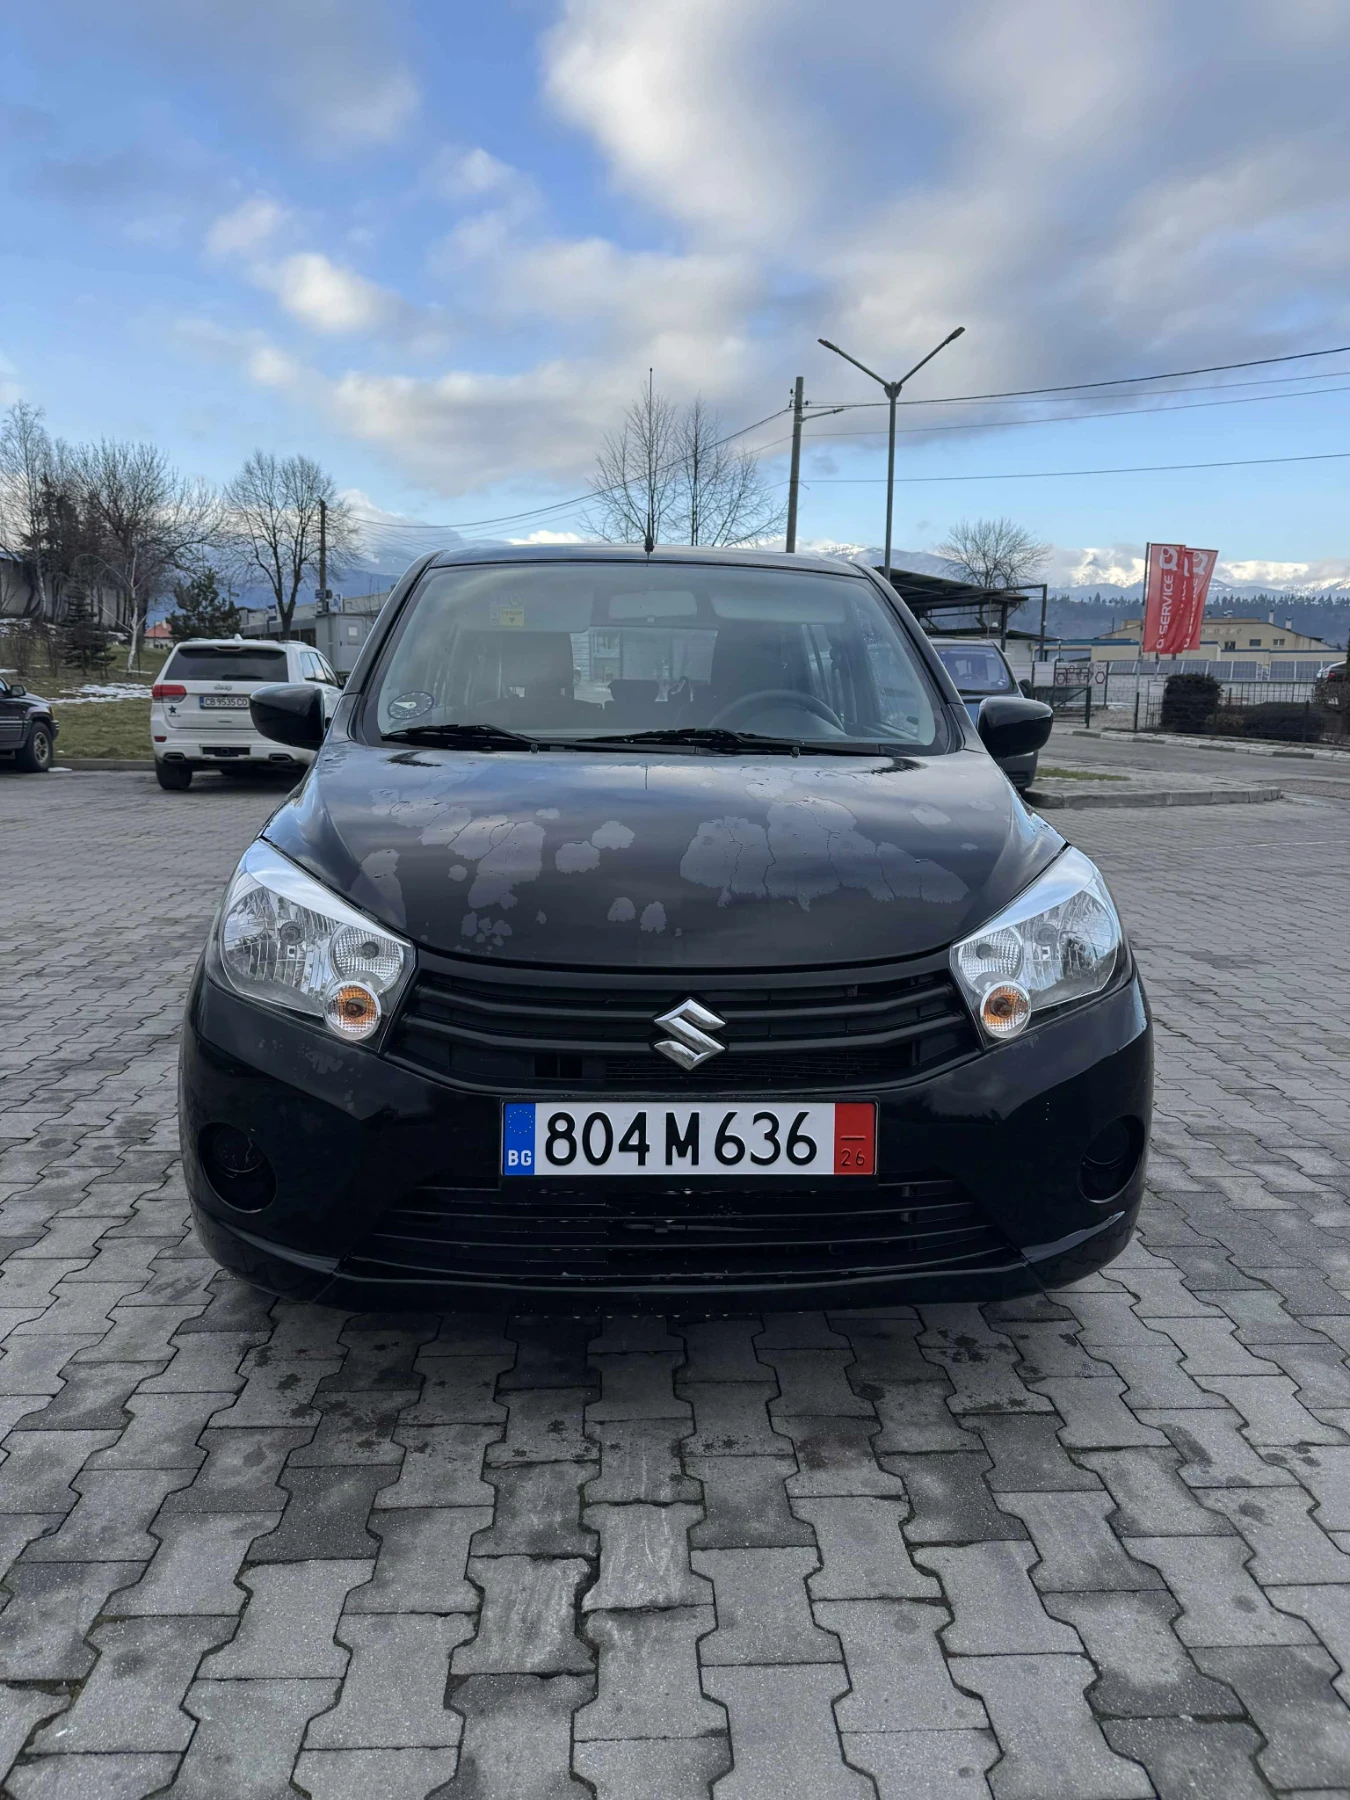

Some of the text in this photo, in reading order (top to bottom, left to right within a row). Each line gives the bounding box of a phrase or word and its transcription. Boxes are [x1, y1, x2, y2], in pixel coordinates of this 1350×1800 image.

[545, 1111, 817, 1166] 804 M 636
[508, 1149, 532, 1167] BG
[841, 1148, 865, 1167] 26
